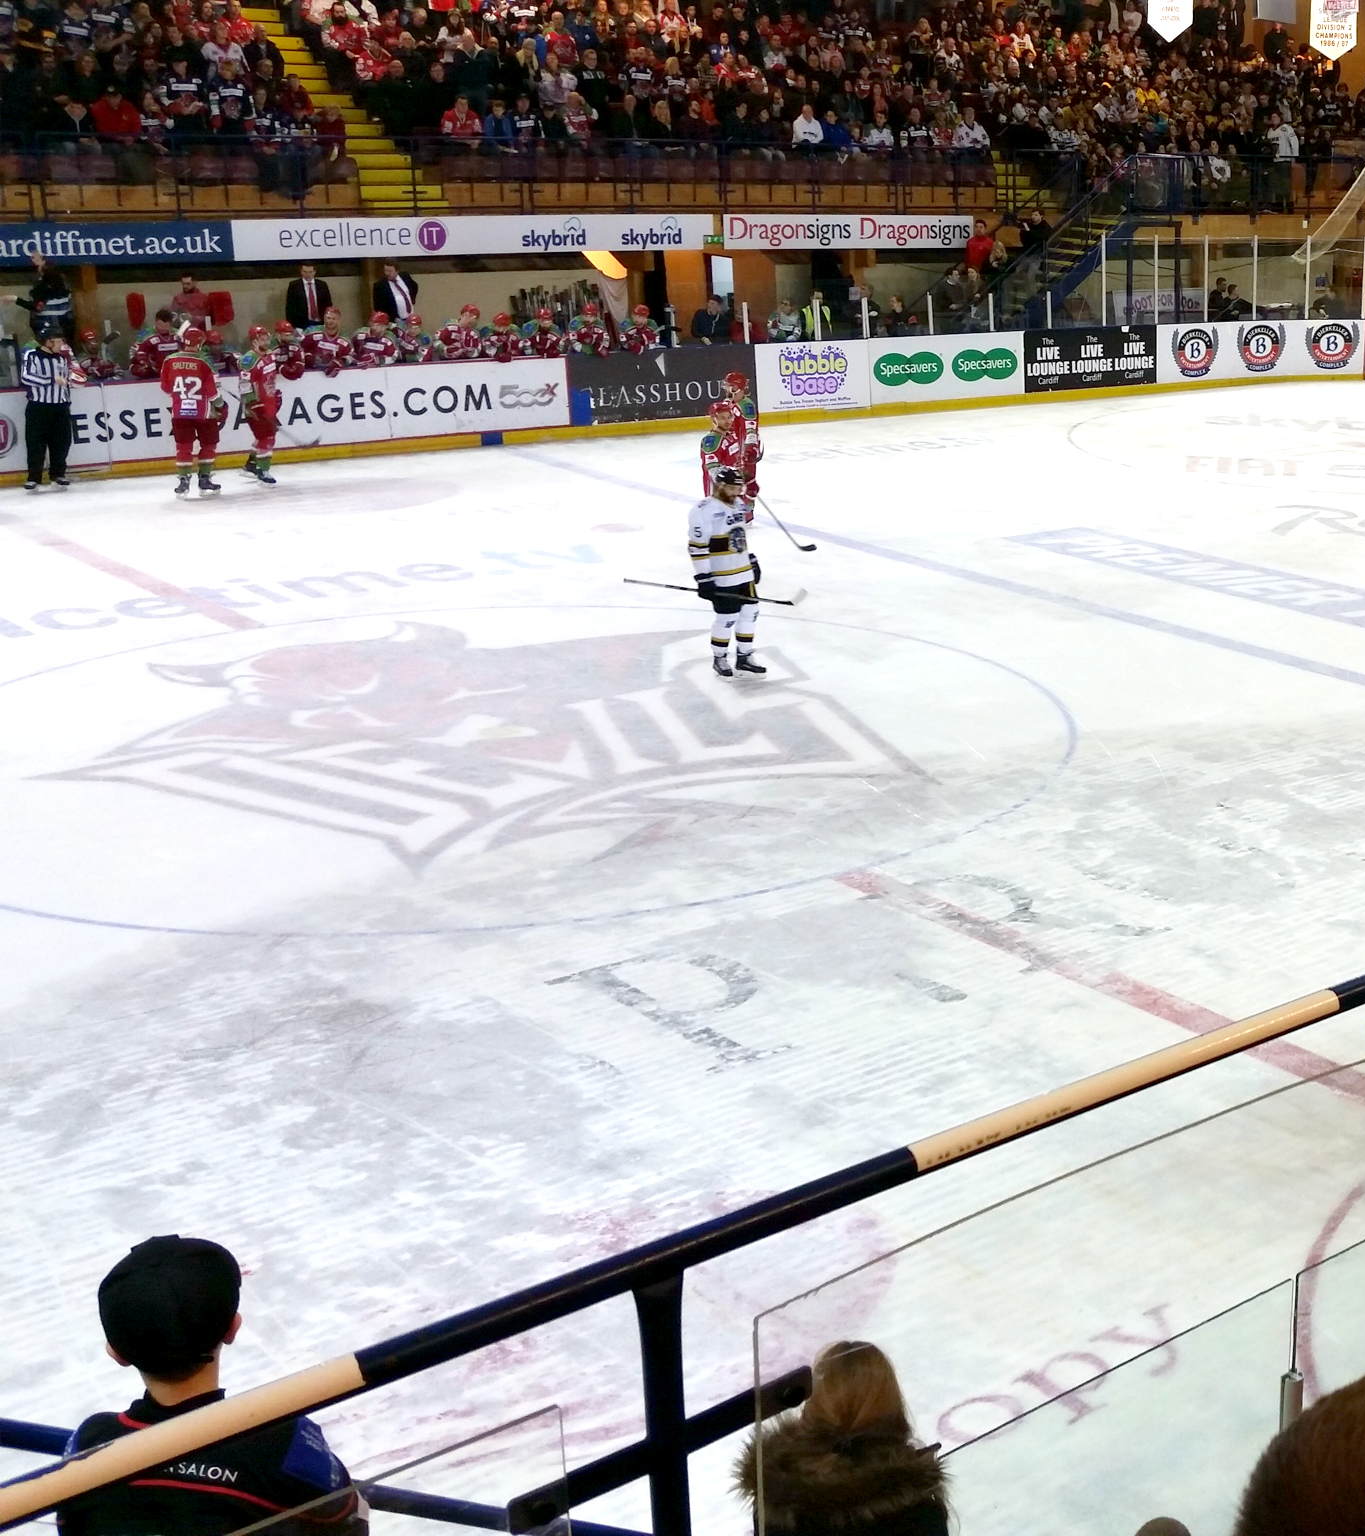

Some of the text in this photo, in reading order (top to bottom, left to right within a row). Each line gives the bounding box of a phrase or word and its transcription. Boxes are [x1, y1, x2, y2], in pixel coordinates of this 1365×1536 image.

[279, 222, 441, 249] excellence IT
[728, 217, 851, 246] Dragonsigns
[859, 217, 970, 246] Dragonsigns
[0, 228, 222, 258] ardiffmet.ac.uk
[1124, 342, 1145, 356] LIVE
[1190, 342, 1200, 359] B
[1255, 337, 1266, 354] B
[1326, 335, 1338, 351] B
[1037, 346, 1060, 360] LIVE
[1081, 344, 1103, 358] LIVE
[779, 352, 848, 376] bubble
[880, 362, 938, 375] Specsavers
[958, 358, 1012, 373] Specsavers
[1027, 361, 1070, 376] LOUNGE
[1071, 358, 1112, 373] LOUNGE
[1115, 356, 1154, 371] LOUNGE
[1038, 377, 1059, 385] Cardiff
[1082, 373, 1102, 382] Cardiff
[1125, 371, 1144, 379] Cardiff
[172, 377, 202, 400] 42
[791, 375, 839, 396] base
[694, 526, 703, 538] 5
[178, 1462, 238, 1482] SALON
